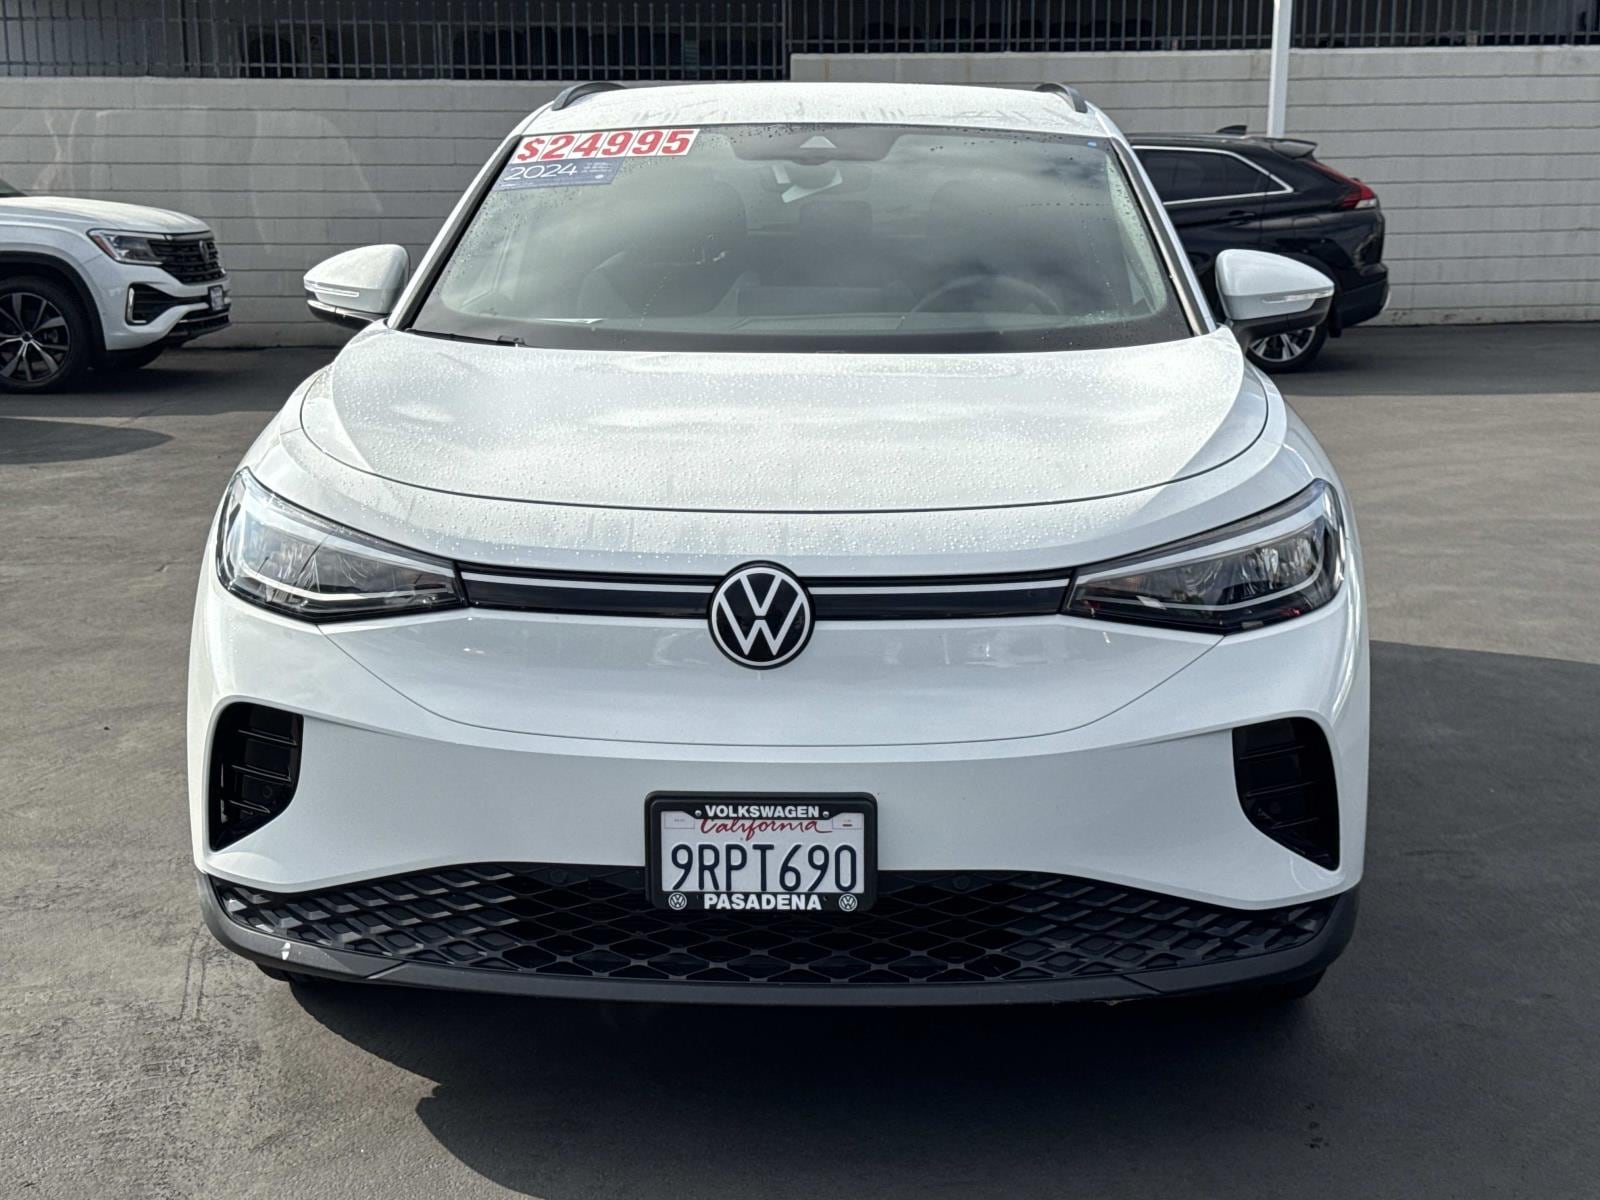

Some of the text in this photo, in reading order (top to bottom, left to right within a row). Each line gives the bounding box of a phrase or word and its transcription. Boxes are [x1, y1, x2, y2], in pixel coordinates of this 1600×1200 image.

[517, 129, 695, 161] $24995
[503, 163, 578, 181] 2024
[704, 805, 820, 818] VOLKSWAGEN
[700, 819, 832, 841] California
[671, 843, 857, 892] 9RPT690
[703, 893, 822, 910] PASADENA
